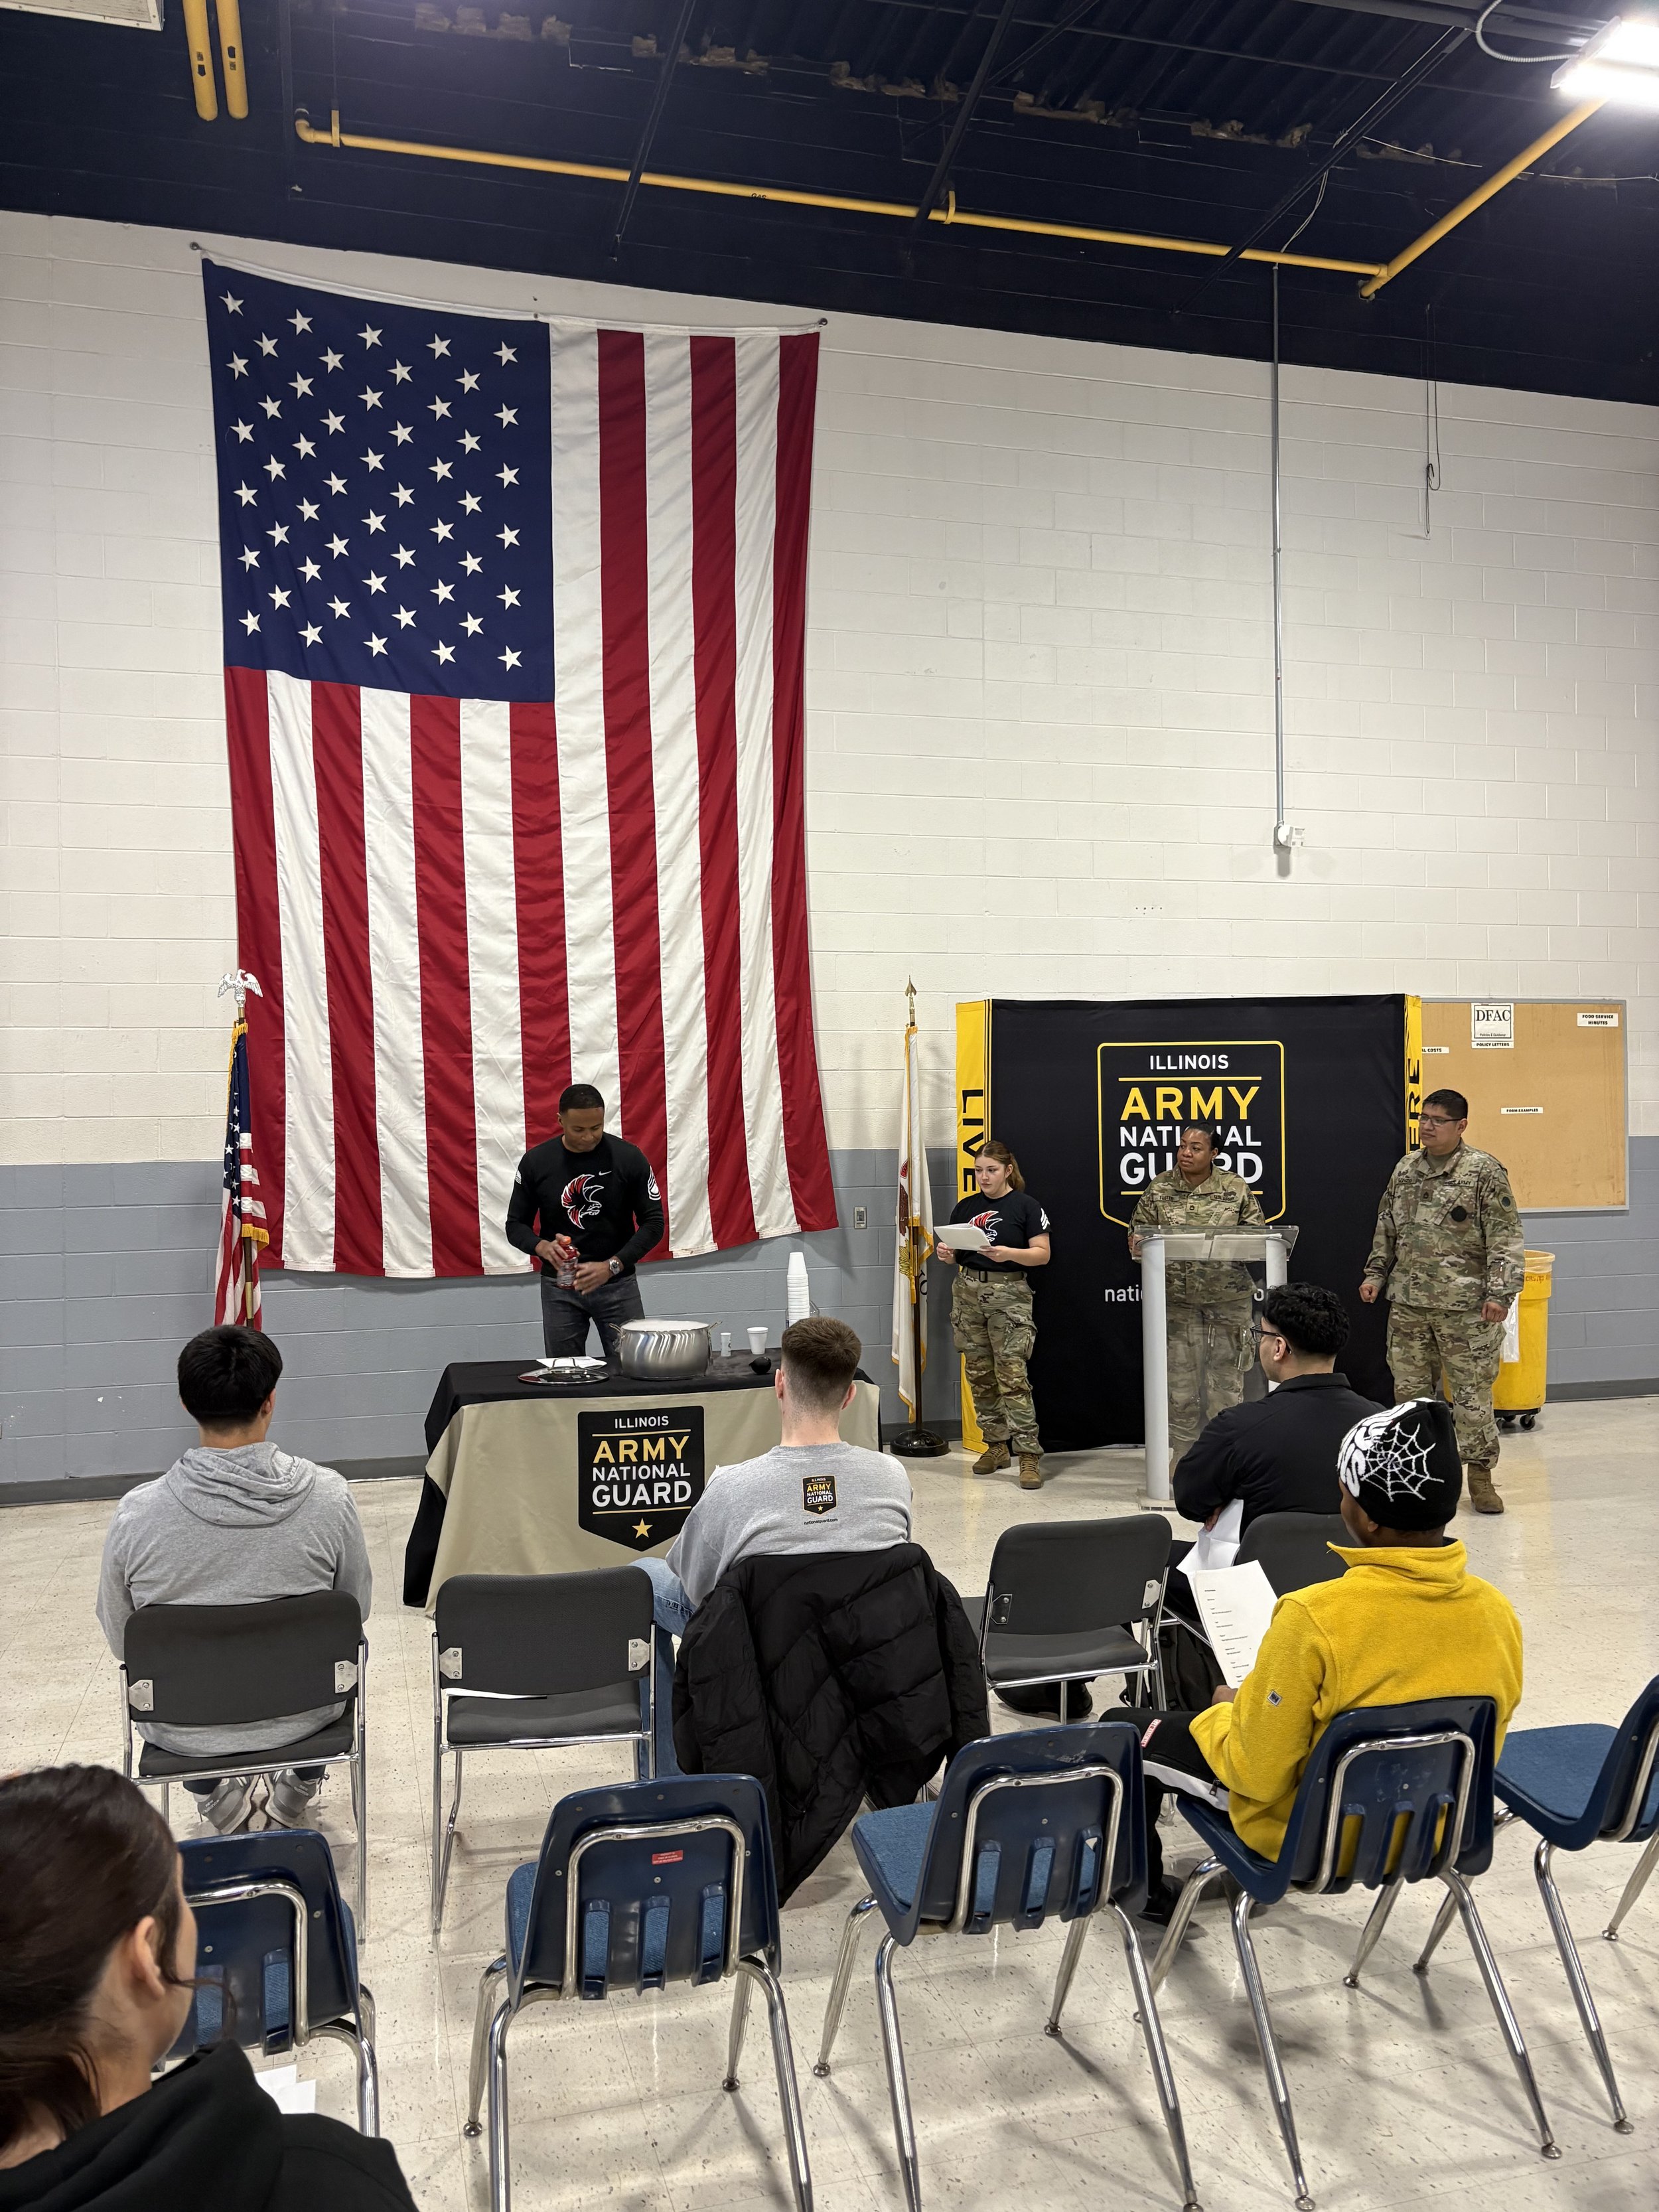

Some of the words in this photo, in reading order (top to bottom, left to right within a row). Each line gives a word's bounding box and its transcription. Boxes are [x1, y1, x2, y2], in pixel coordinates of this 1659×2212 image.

[1476, 1009, 1510, 1021] DFAC
[1149, 1054, 1229, 1070] ILLINOIS
[1120, 1086, 1260, 1120] ARMY
[1119, 1126, 1262, 1147] NATIAL
[614, 1416, 669, 1429] ILLINOIS
[593, 1436, 689, 1463] ARMY
[593, 1462, 691, 1481] NATIONAL
[592, 1480, 691, 1507] GUARD
[806, 1483, 831, 1493] ARMY
[807, 1495, 833, 1504] GUARD
